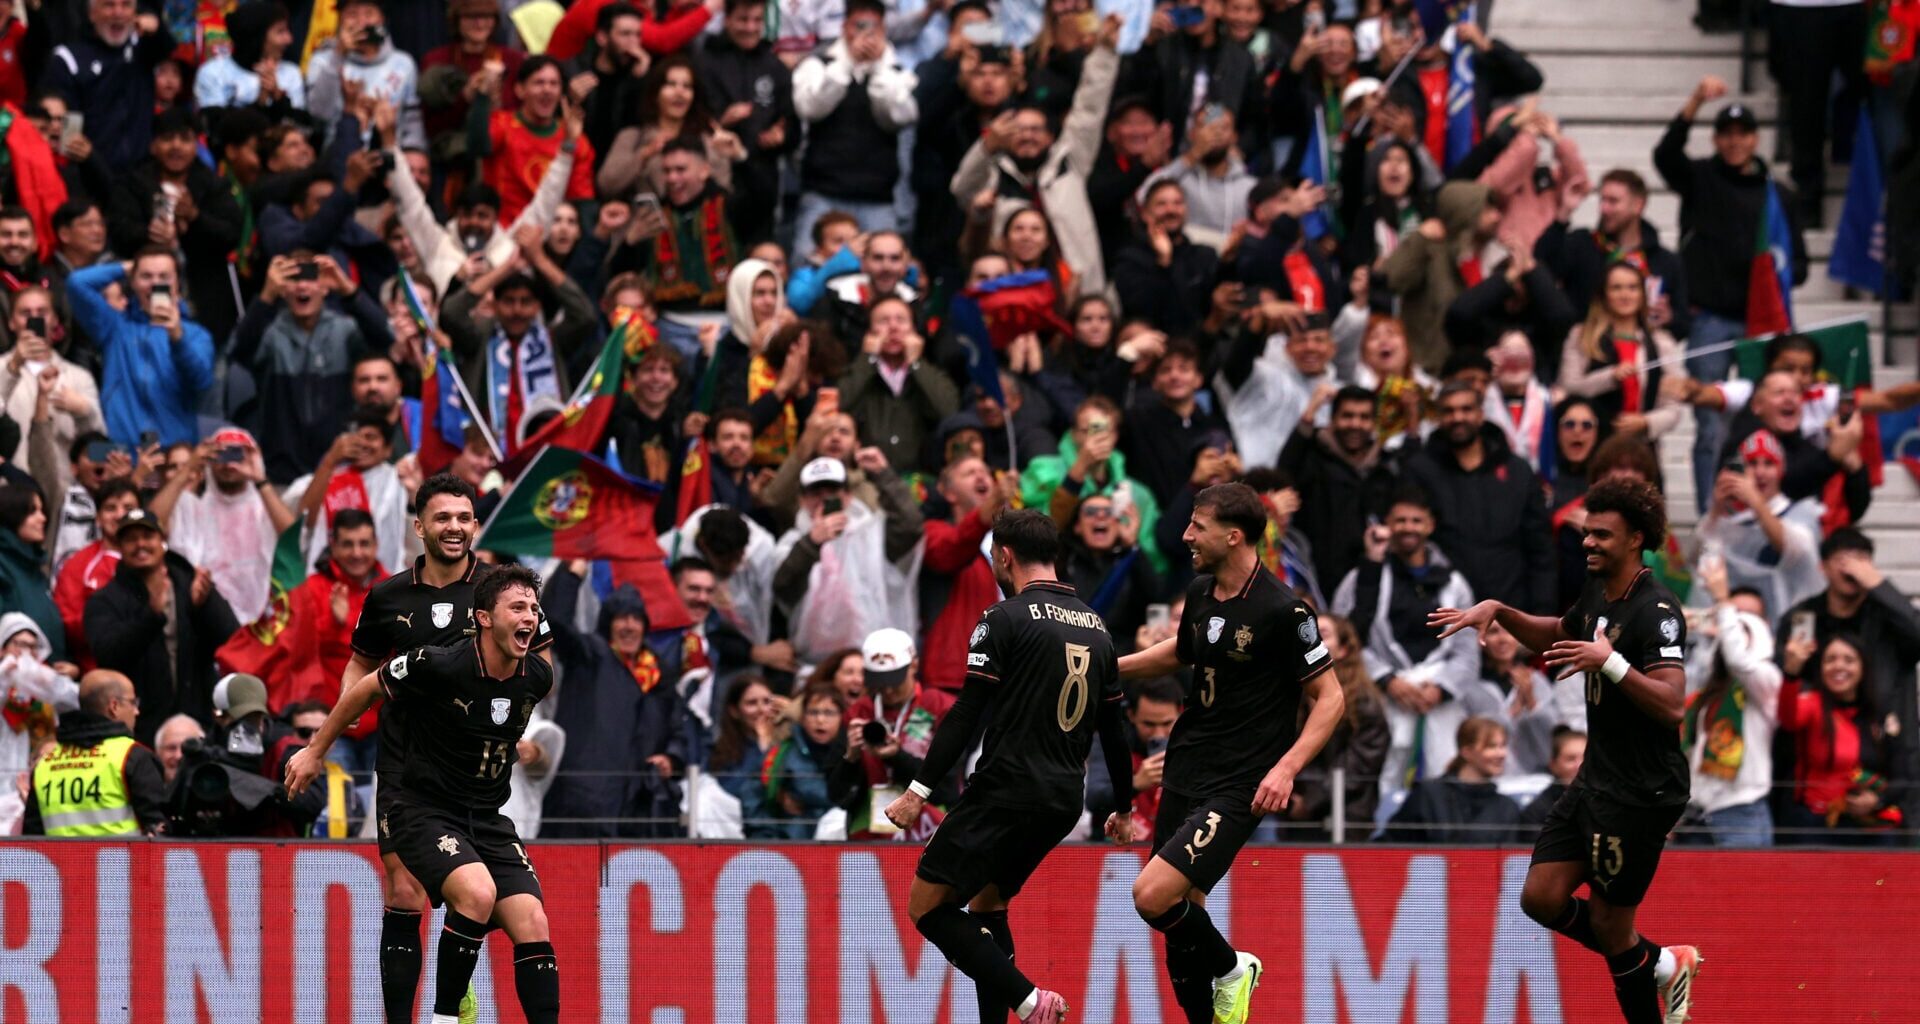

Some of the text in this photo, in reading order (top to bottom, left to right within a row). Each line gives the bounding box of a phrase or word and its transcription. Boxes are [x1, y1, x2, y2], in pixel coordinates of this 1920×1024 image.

[1028, 603, 1046, 620] B.
[1057, 642, 1091, 732] 8
[1201, 666, 1216, 708] 3
[475, 740, 509, 779] 15
[42, 775, 102, 807] 1104
[1193, 811, 1223, 848] 3
[1592, 833, 1623, 875] 13
[599, 847, 981, 1024] COM
